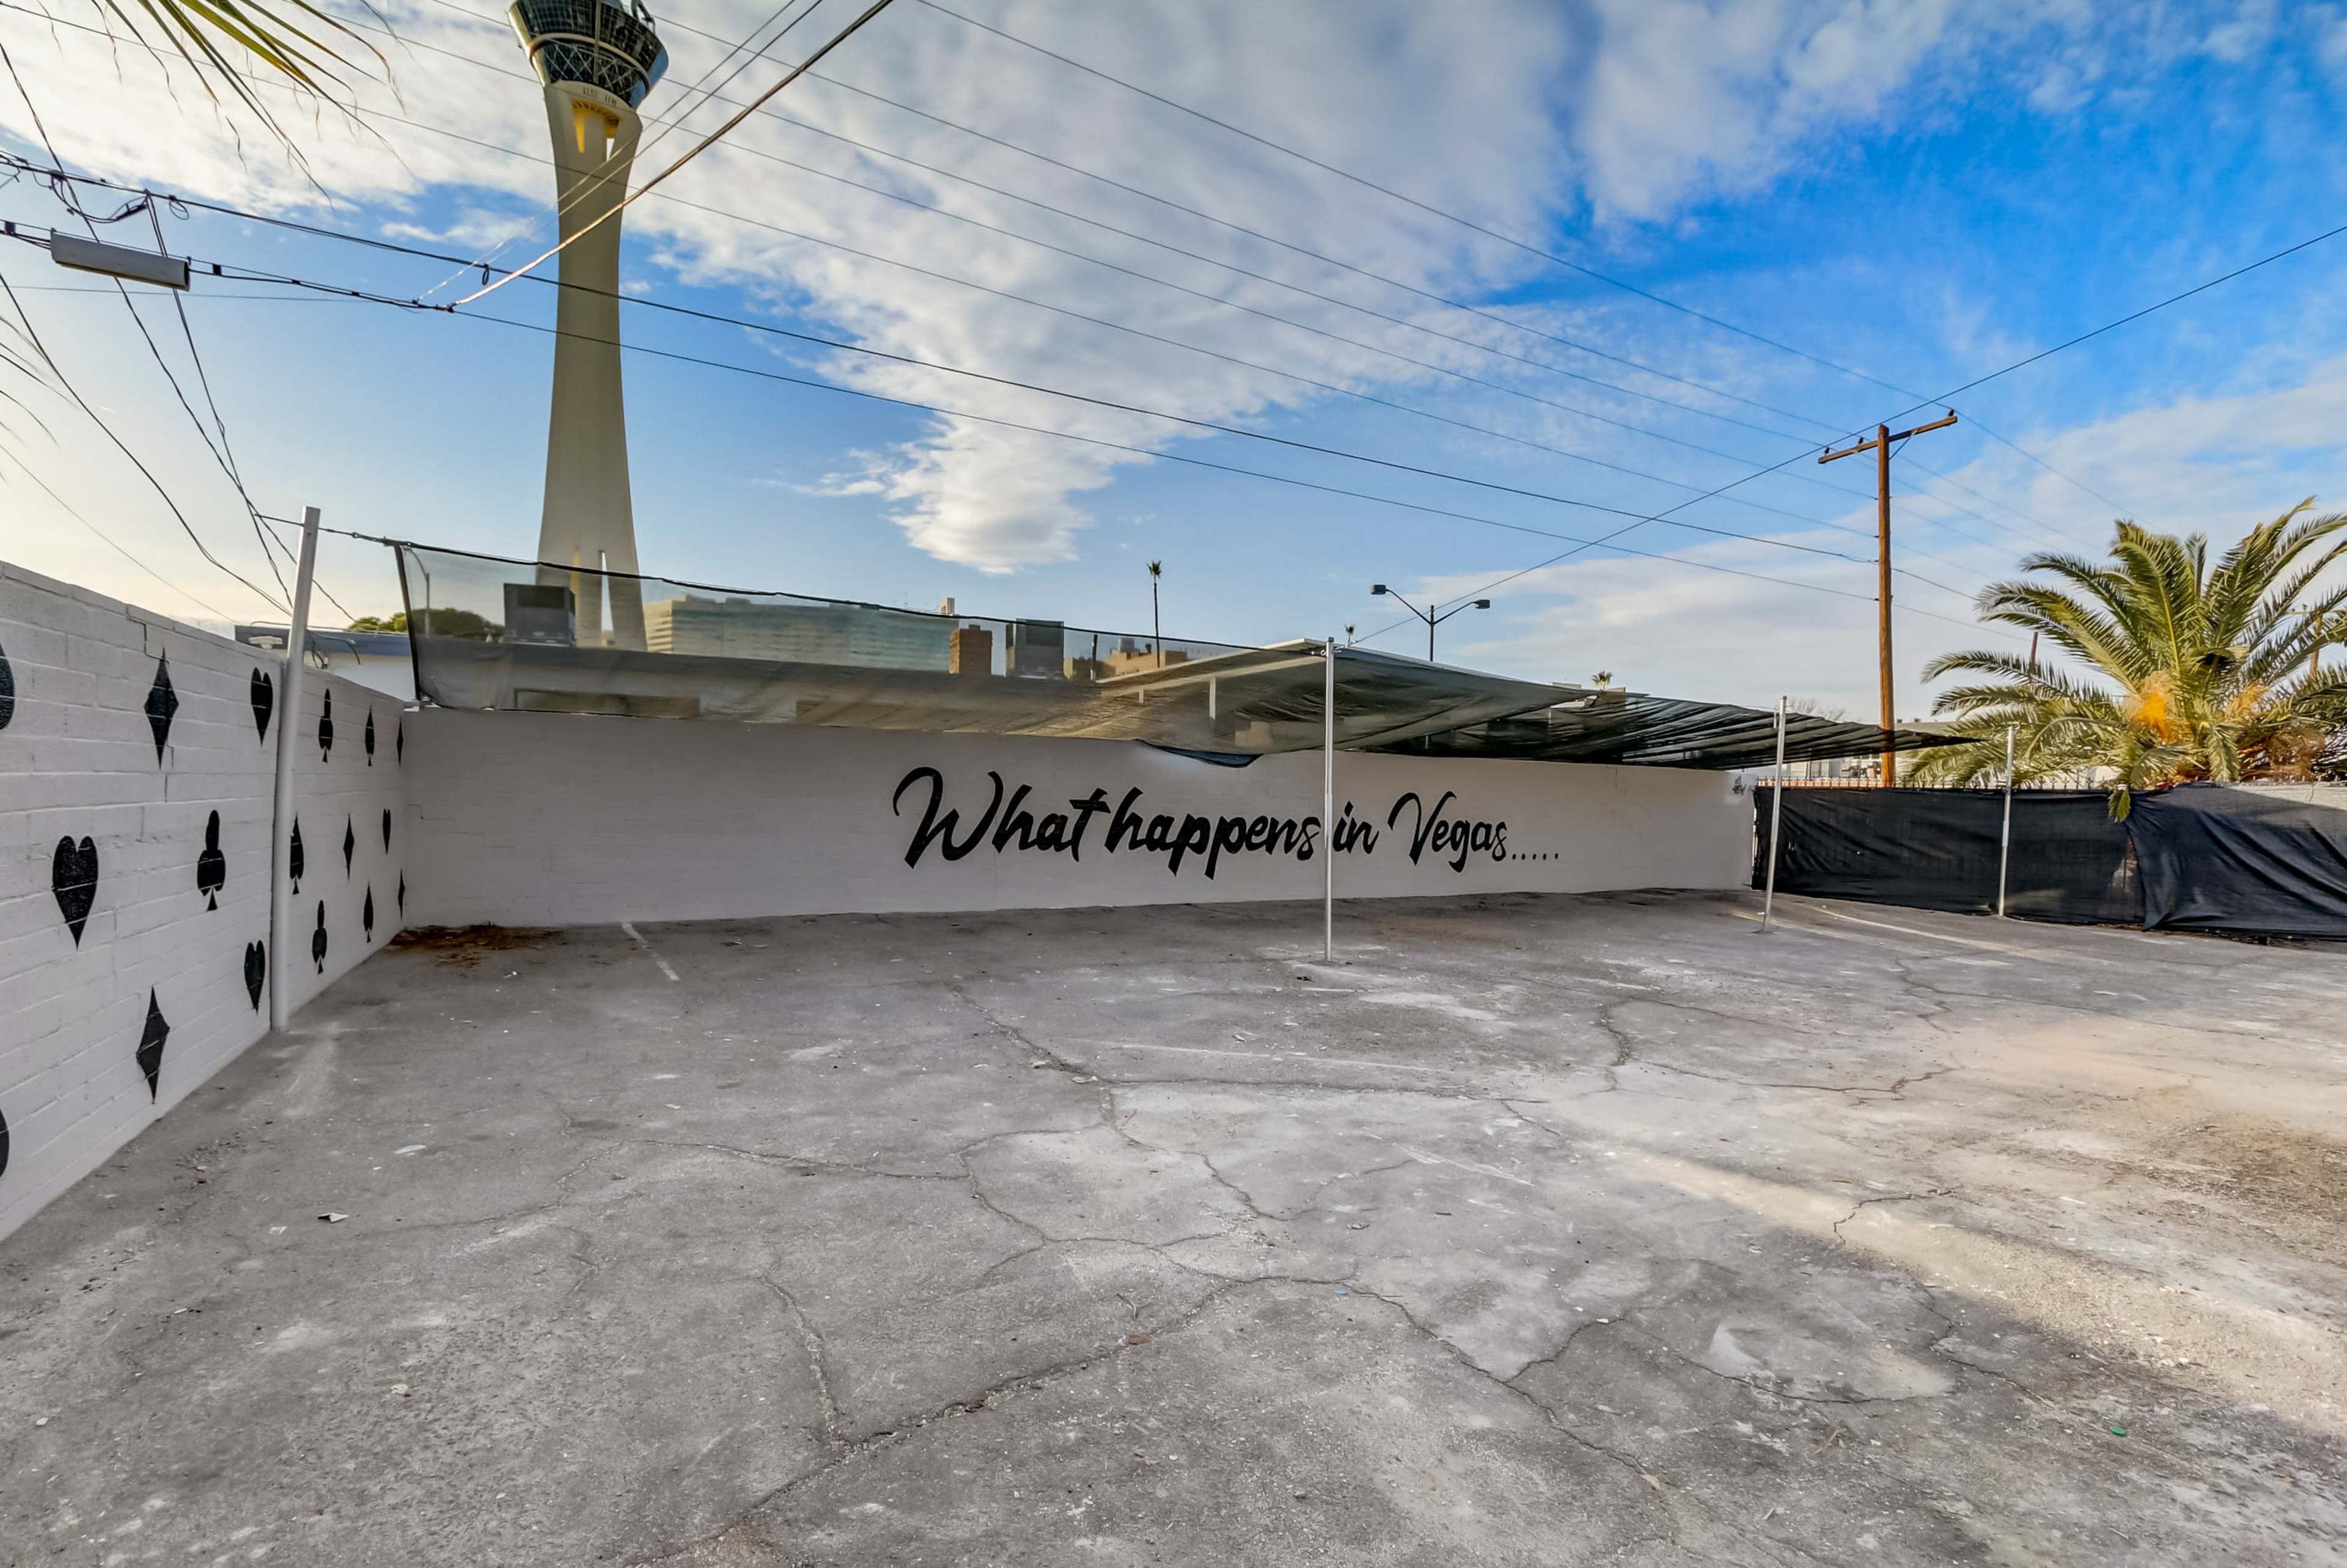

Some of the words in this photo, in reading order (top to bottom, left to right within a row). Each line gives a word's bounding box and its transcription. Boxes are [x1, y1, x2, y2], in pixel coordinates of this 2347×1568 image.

[893, 766, 1111, 869] What
[1104, 786, 1321, 880] happens
[1332, 800, 1379, 854] in
